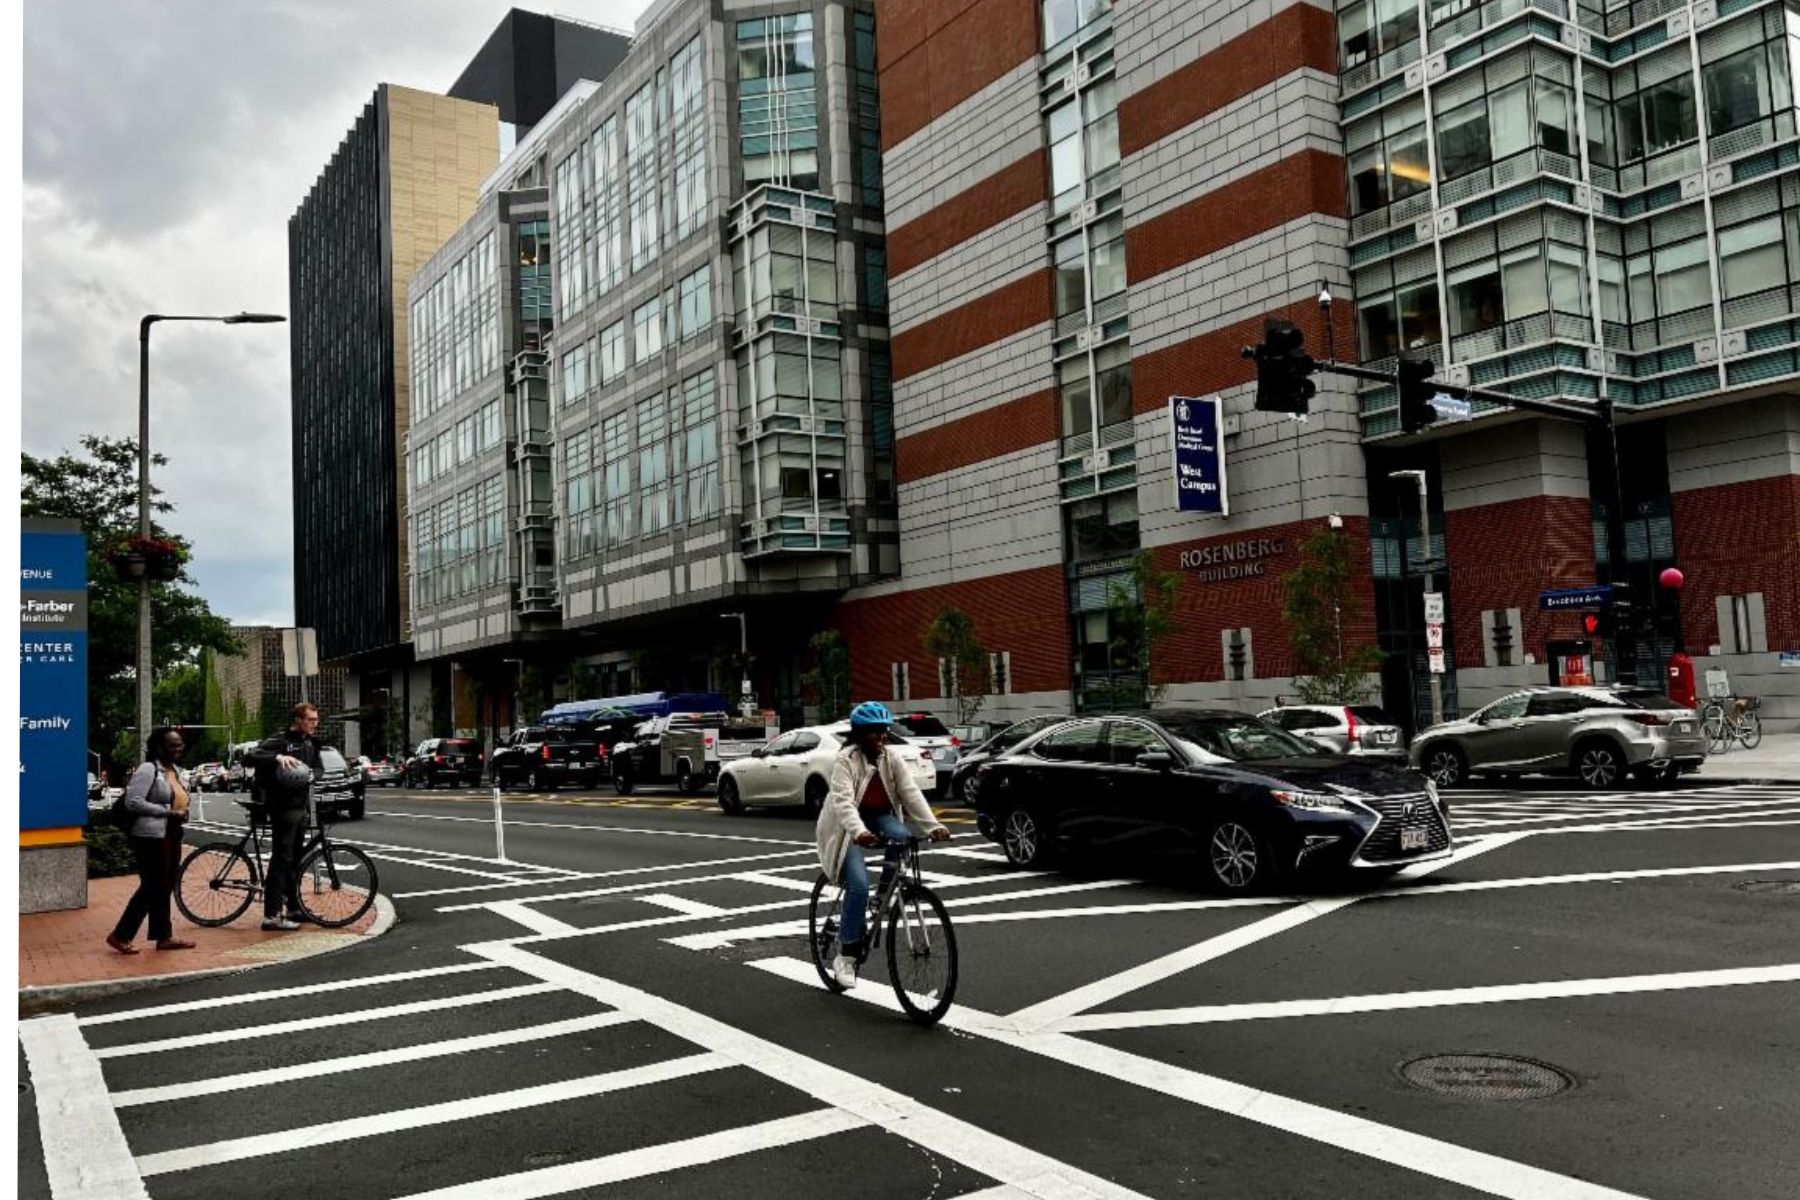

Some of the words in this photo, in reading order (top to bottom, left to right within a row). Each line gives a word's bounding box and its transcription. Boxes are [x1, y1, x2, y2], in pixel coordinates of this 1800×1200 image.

[1180, 464, 1202, 477] West
[1181, 478, 1217, 494] Campus
[1181, 539, 1284, 569] ROSENBERG
[20, 569, 53, 579] ENUE
[1200, 562, 1263, 582] BUILDING
[20, 600, 75, 612] -Farber
[22, 613, 65, 622] Institute
[20, 643, 73, 653] ENTER
[20, 716, 71, 731] Family
